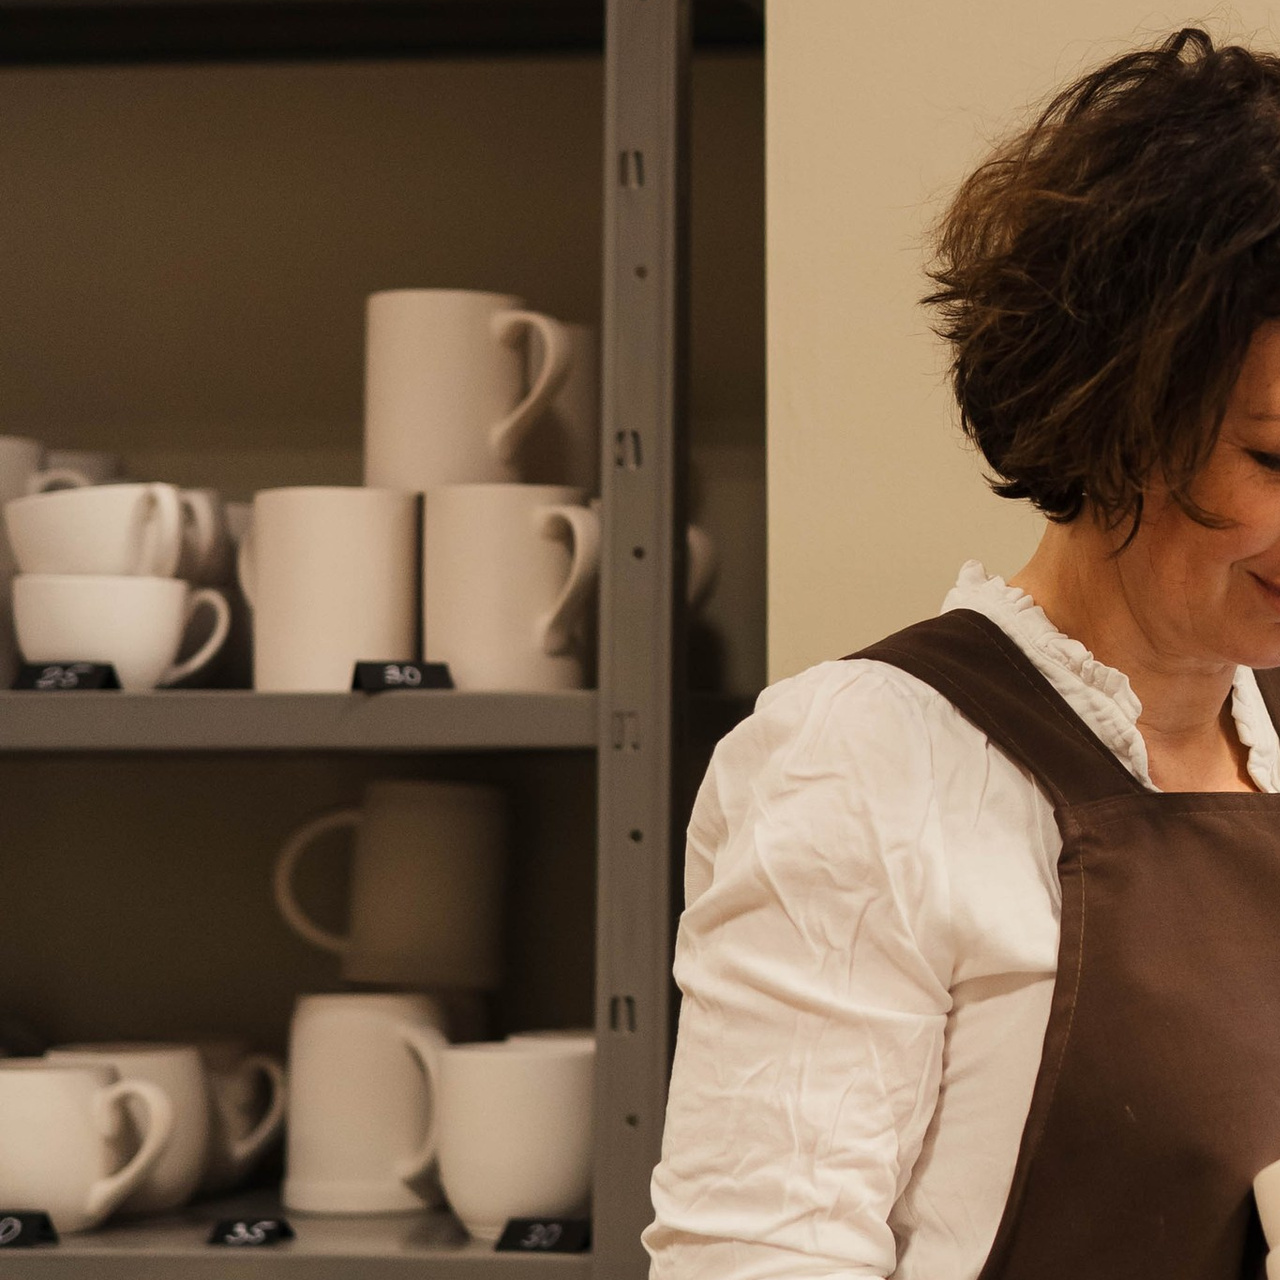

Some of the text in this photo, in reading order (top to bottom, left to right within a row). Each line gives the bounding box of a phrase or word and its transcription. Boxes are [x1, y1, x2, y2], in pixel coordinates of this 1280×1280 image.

[384, 664, 422, 686] 30
[226, 1221, 278, 1245] 35
[522, 1223, 562, 1248] 30
